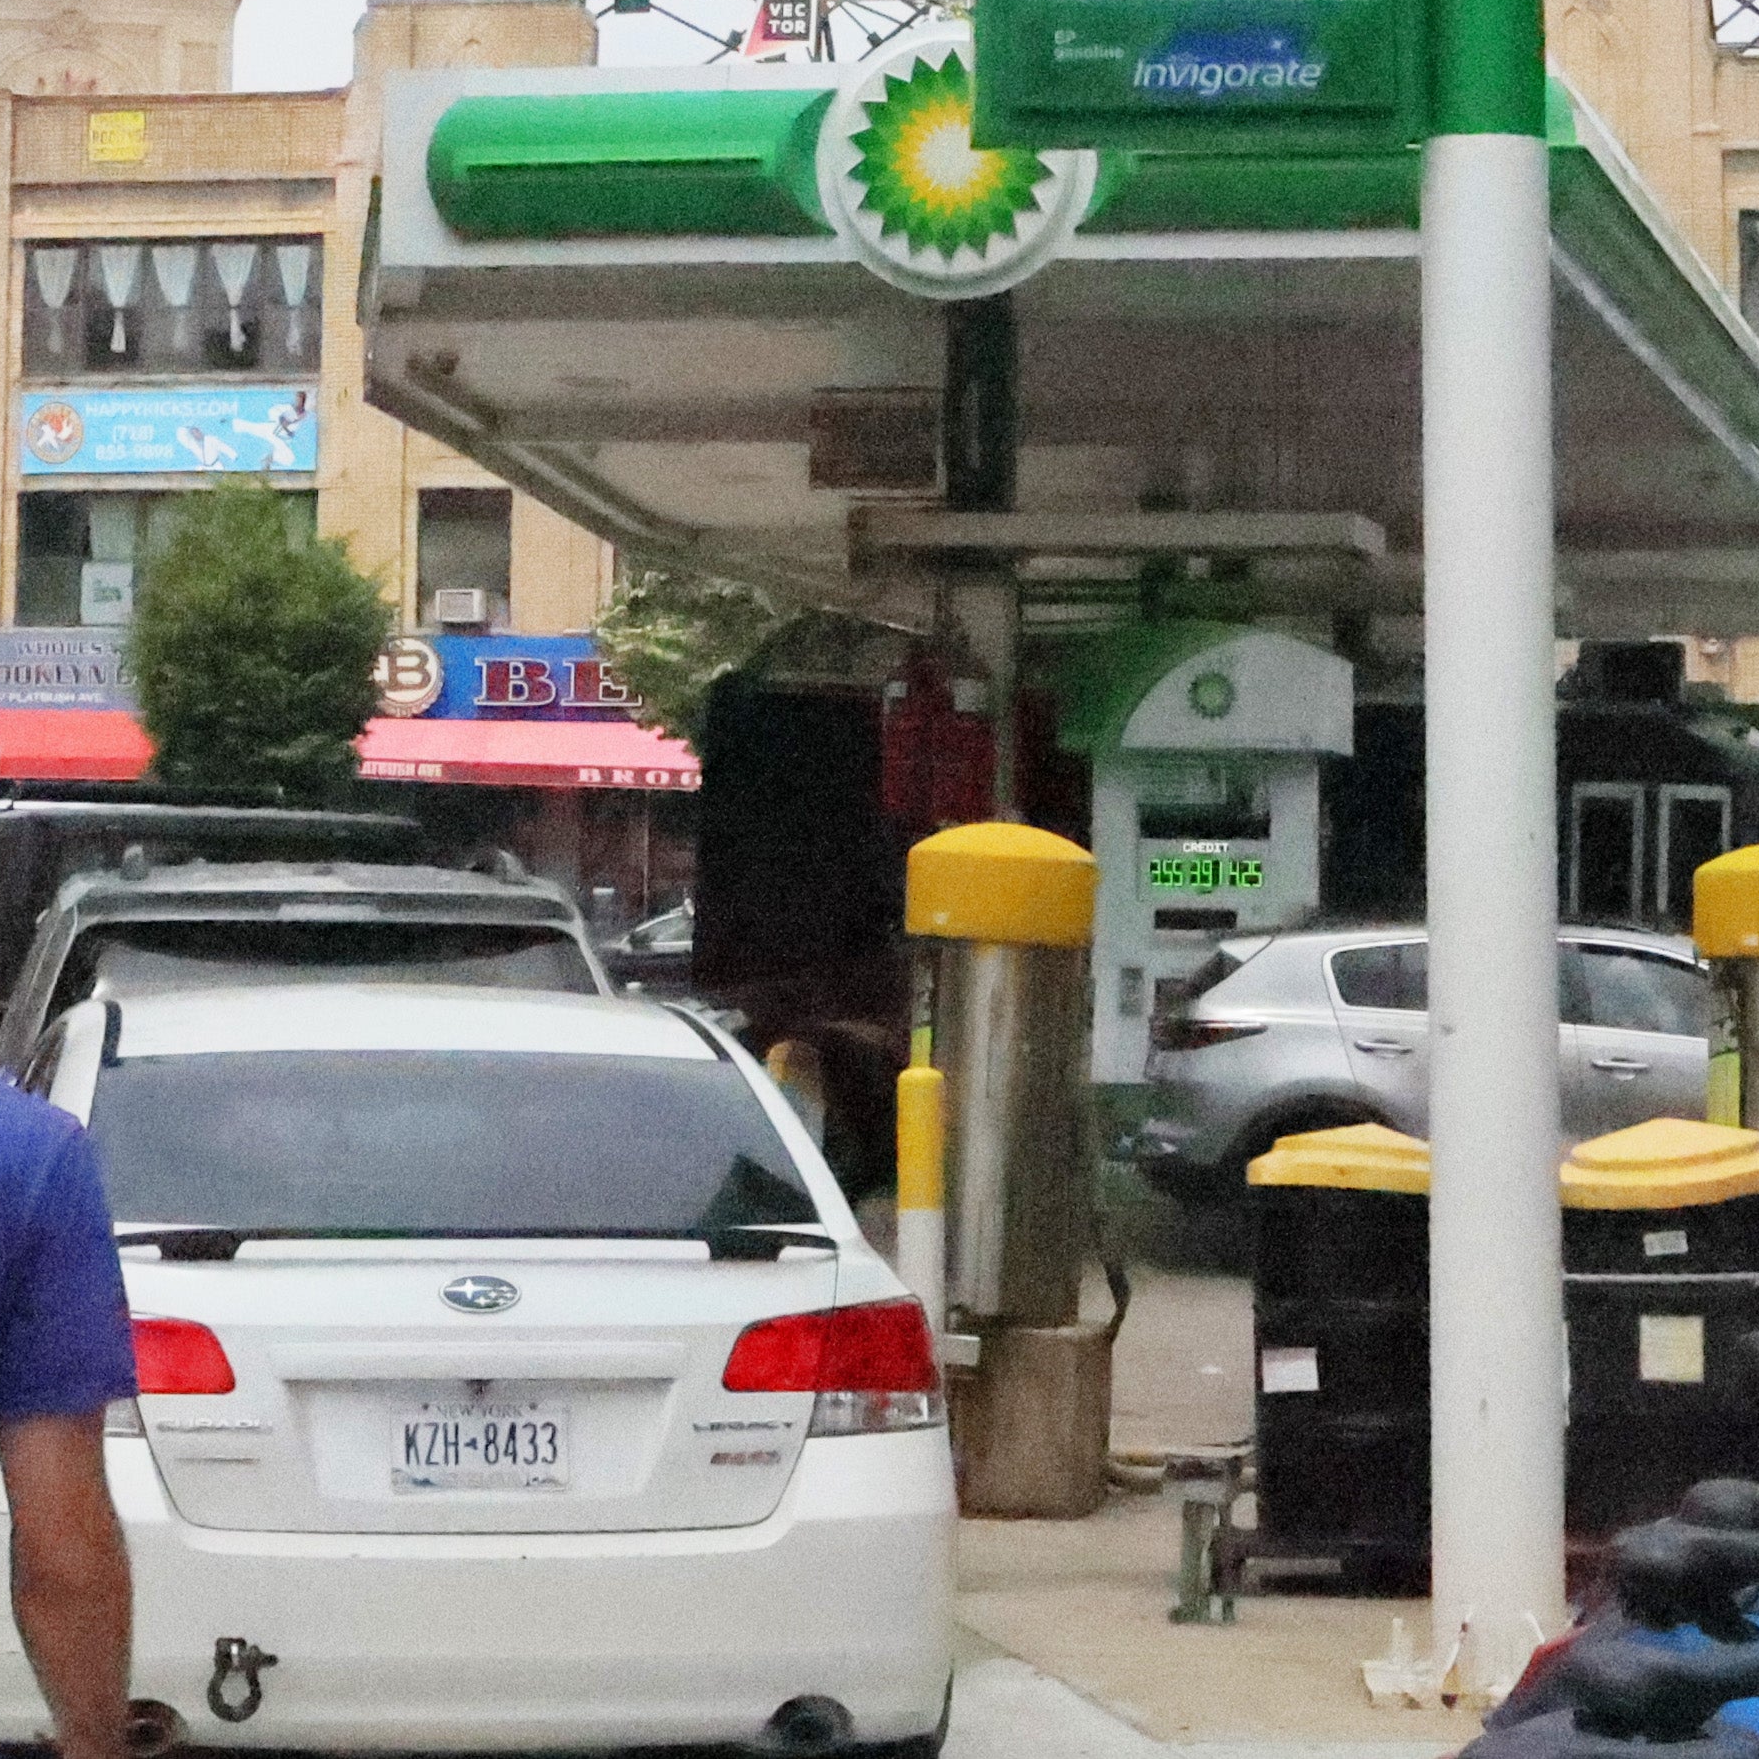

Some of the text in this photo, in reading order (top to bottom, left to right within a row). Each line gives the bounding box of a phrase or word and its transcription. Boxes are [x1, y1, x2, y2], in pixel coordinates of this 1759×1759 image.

[768, 2, 806, 18] VEC
[768, 19, 807, 34] TOR
[1133, 57, 1325, 96] Invigorate
[85, 399, 239, 418] HAPPYKICKS.COM
[1182, 842, 1230, 854] CREDIT
